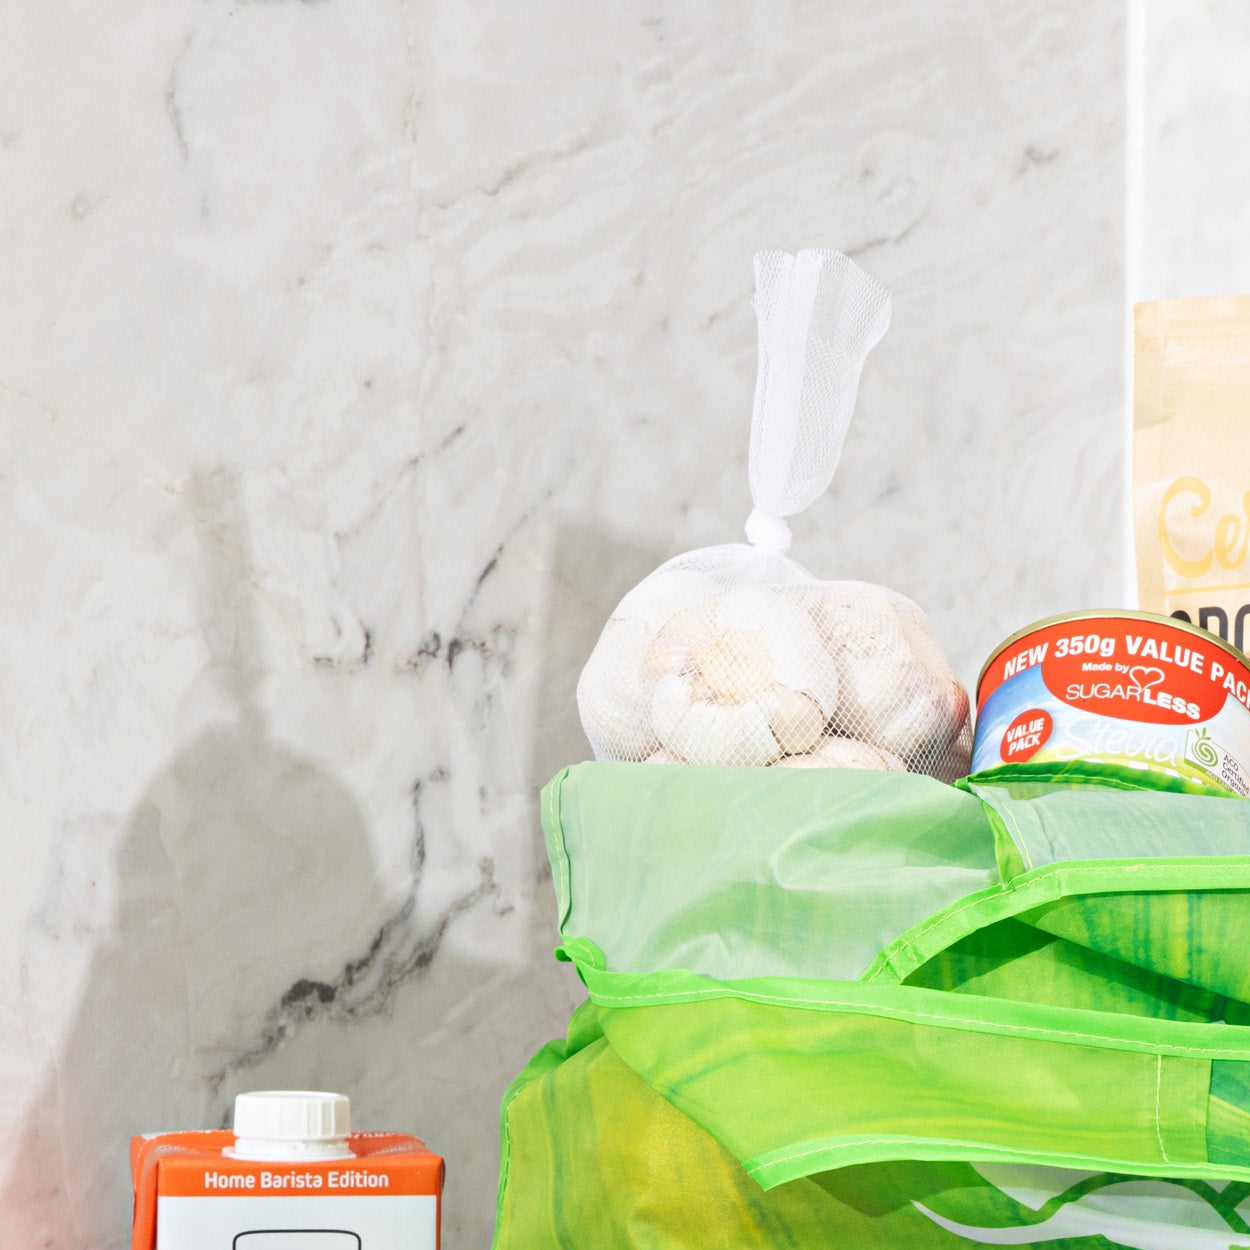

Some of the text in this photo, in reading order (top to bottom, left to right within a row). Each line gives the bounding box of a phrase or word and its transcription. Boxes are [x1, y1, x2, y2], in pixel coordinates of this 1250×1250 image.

[1003, 642, 1049, 681] NEW
[1054, 634, 1116, 658] 350g
[1125, 635, 1205, 676] VALUE
[1081, 662, 1130, 674] Made by
[1006, 717, 1045, 756] VALUE PACK
[204, 1171, 389, 1188] Home Barista Edition
